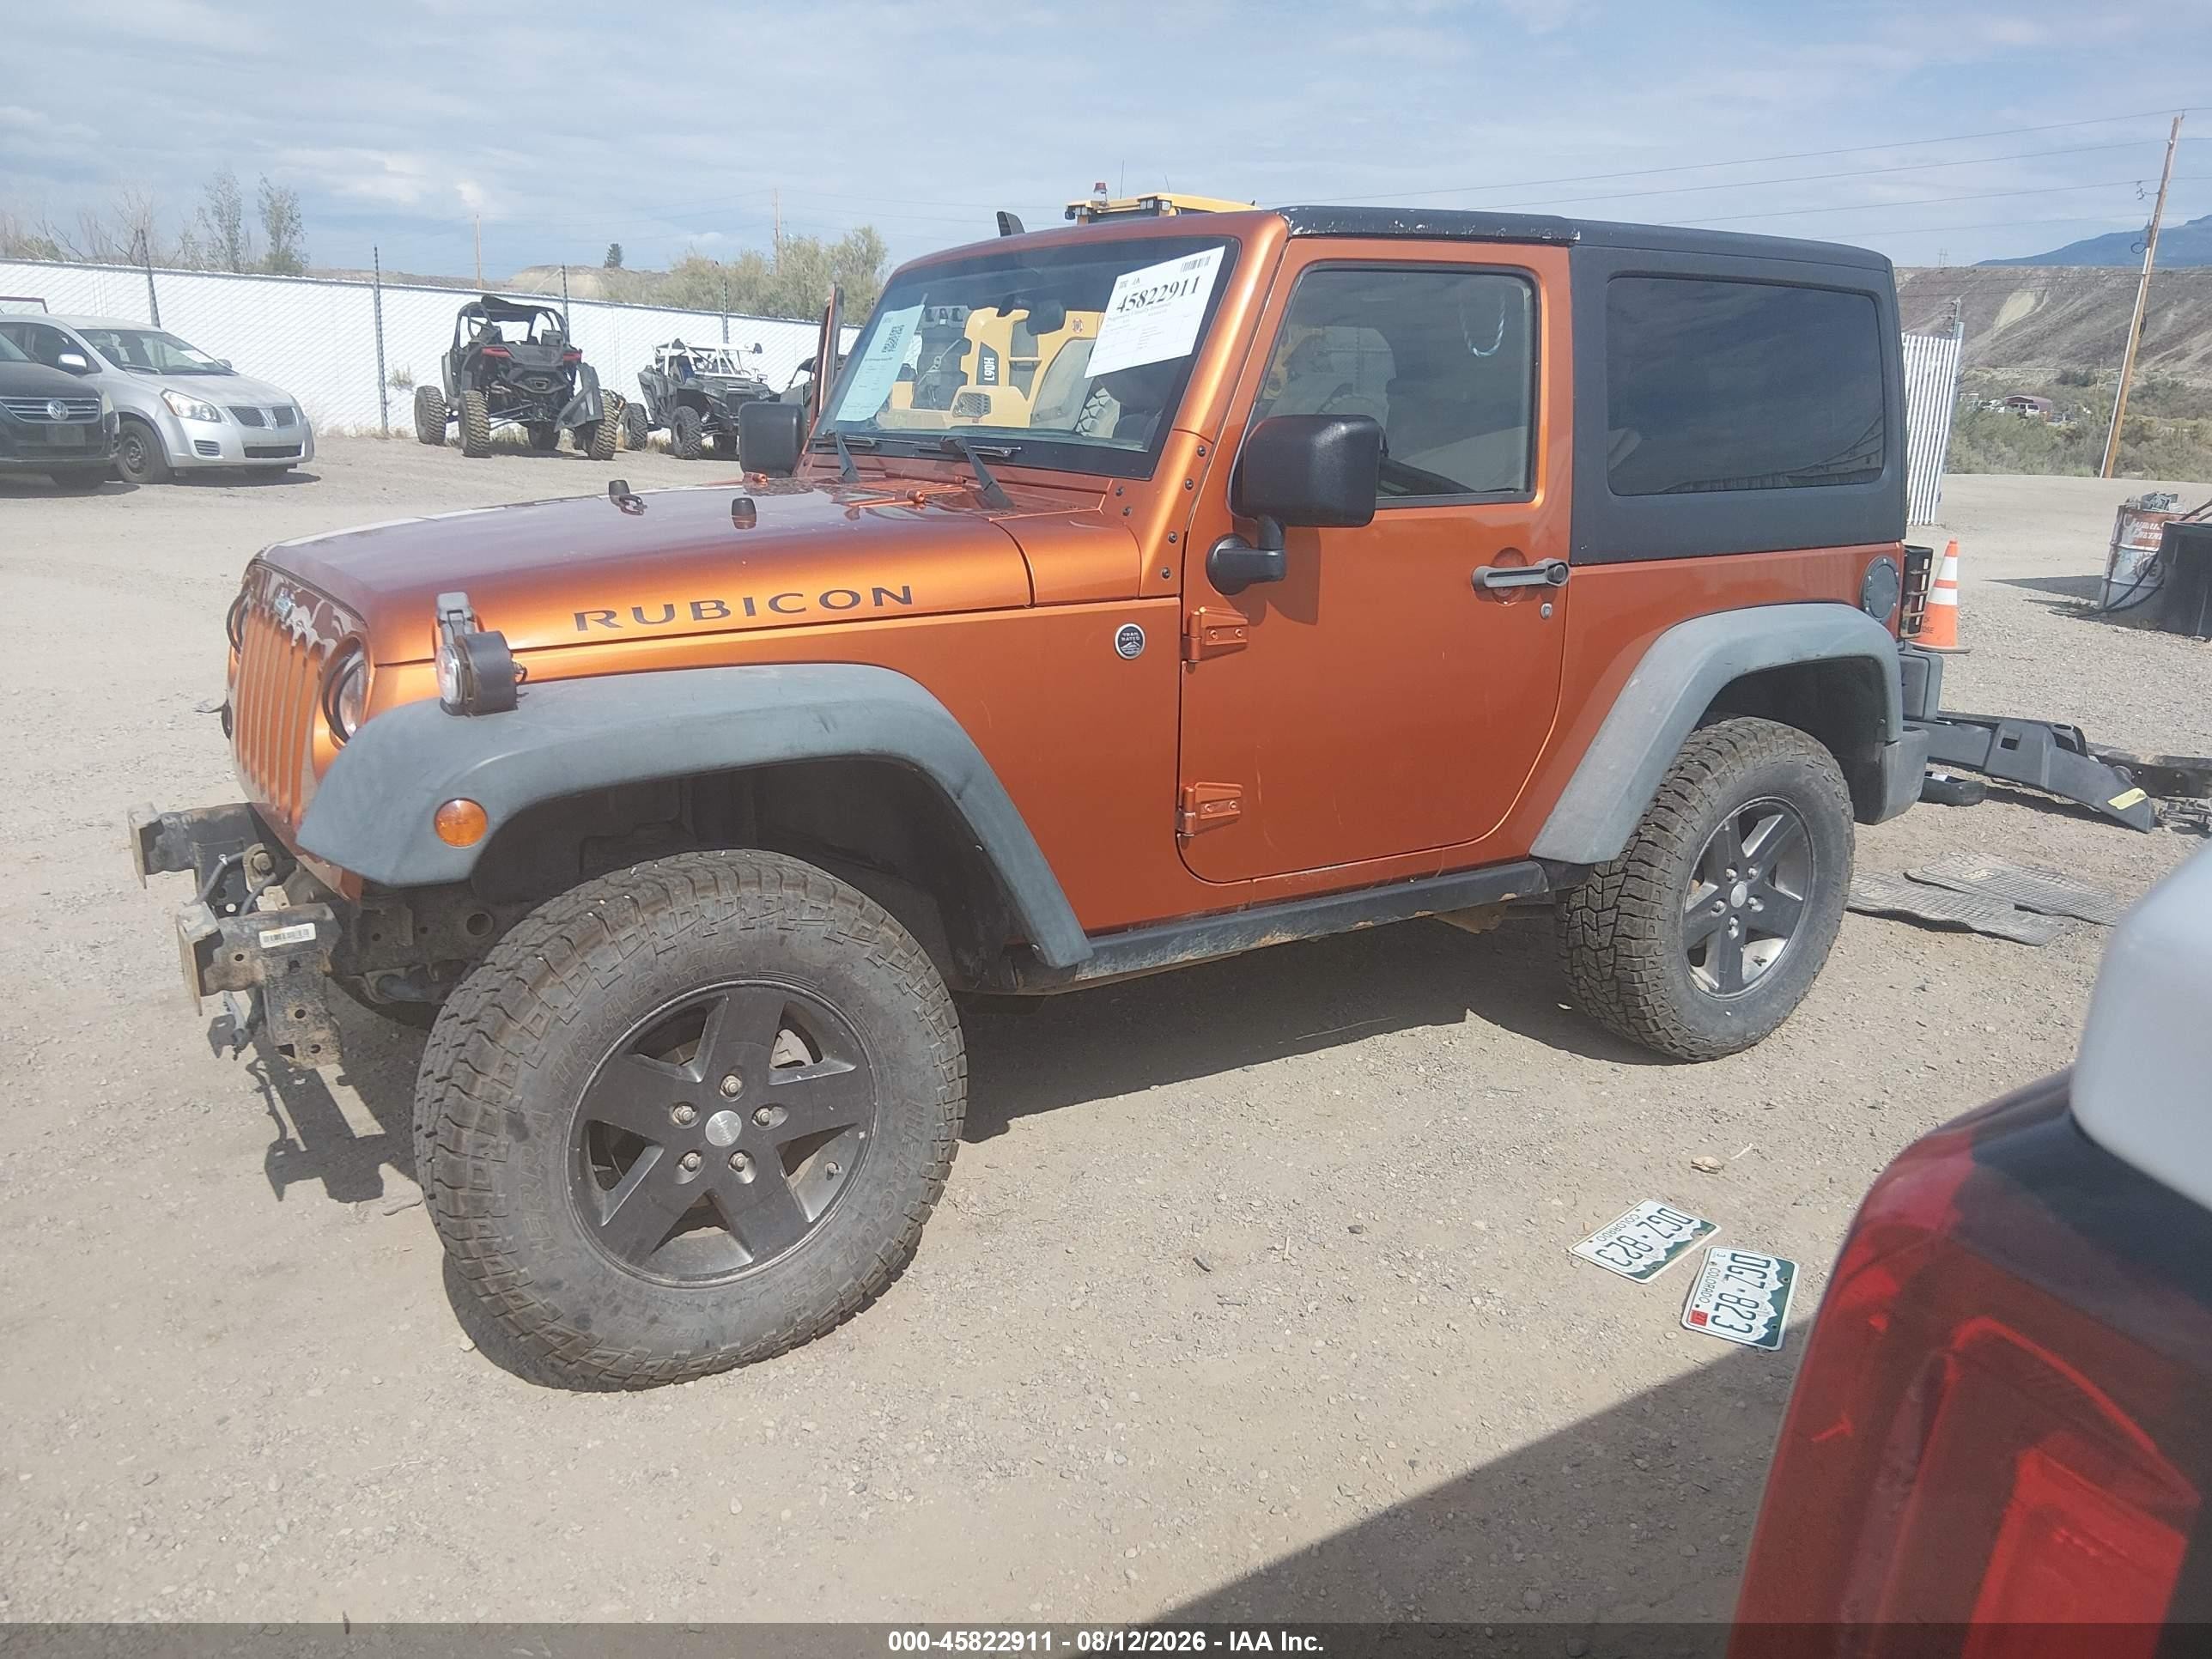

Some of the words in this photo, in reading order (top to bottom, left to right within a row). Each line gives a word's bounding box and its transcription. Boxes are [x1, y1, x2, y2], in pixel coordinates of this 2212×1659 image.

[1116, 276, 1200, 313] 45822911
[983, 356, 995, 381] L90H
[574, 585, 913, 632] RUBICON
[1598, 1213, 1640, 1243] COLORADO
[1698, 1267, 1722, 1304] COLORADO
